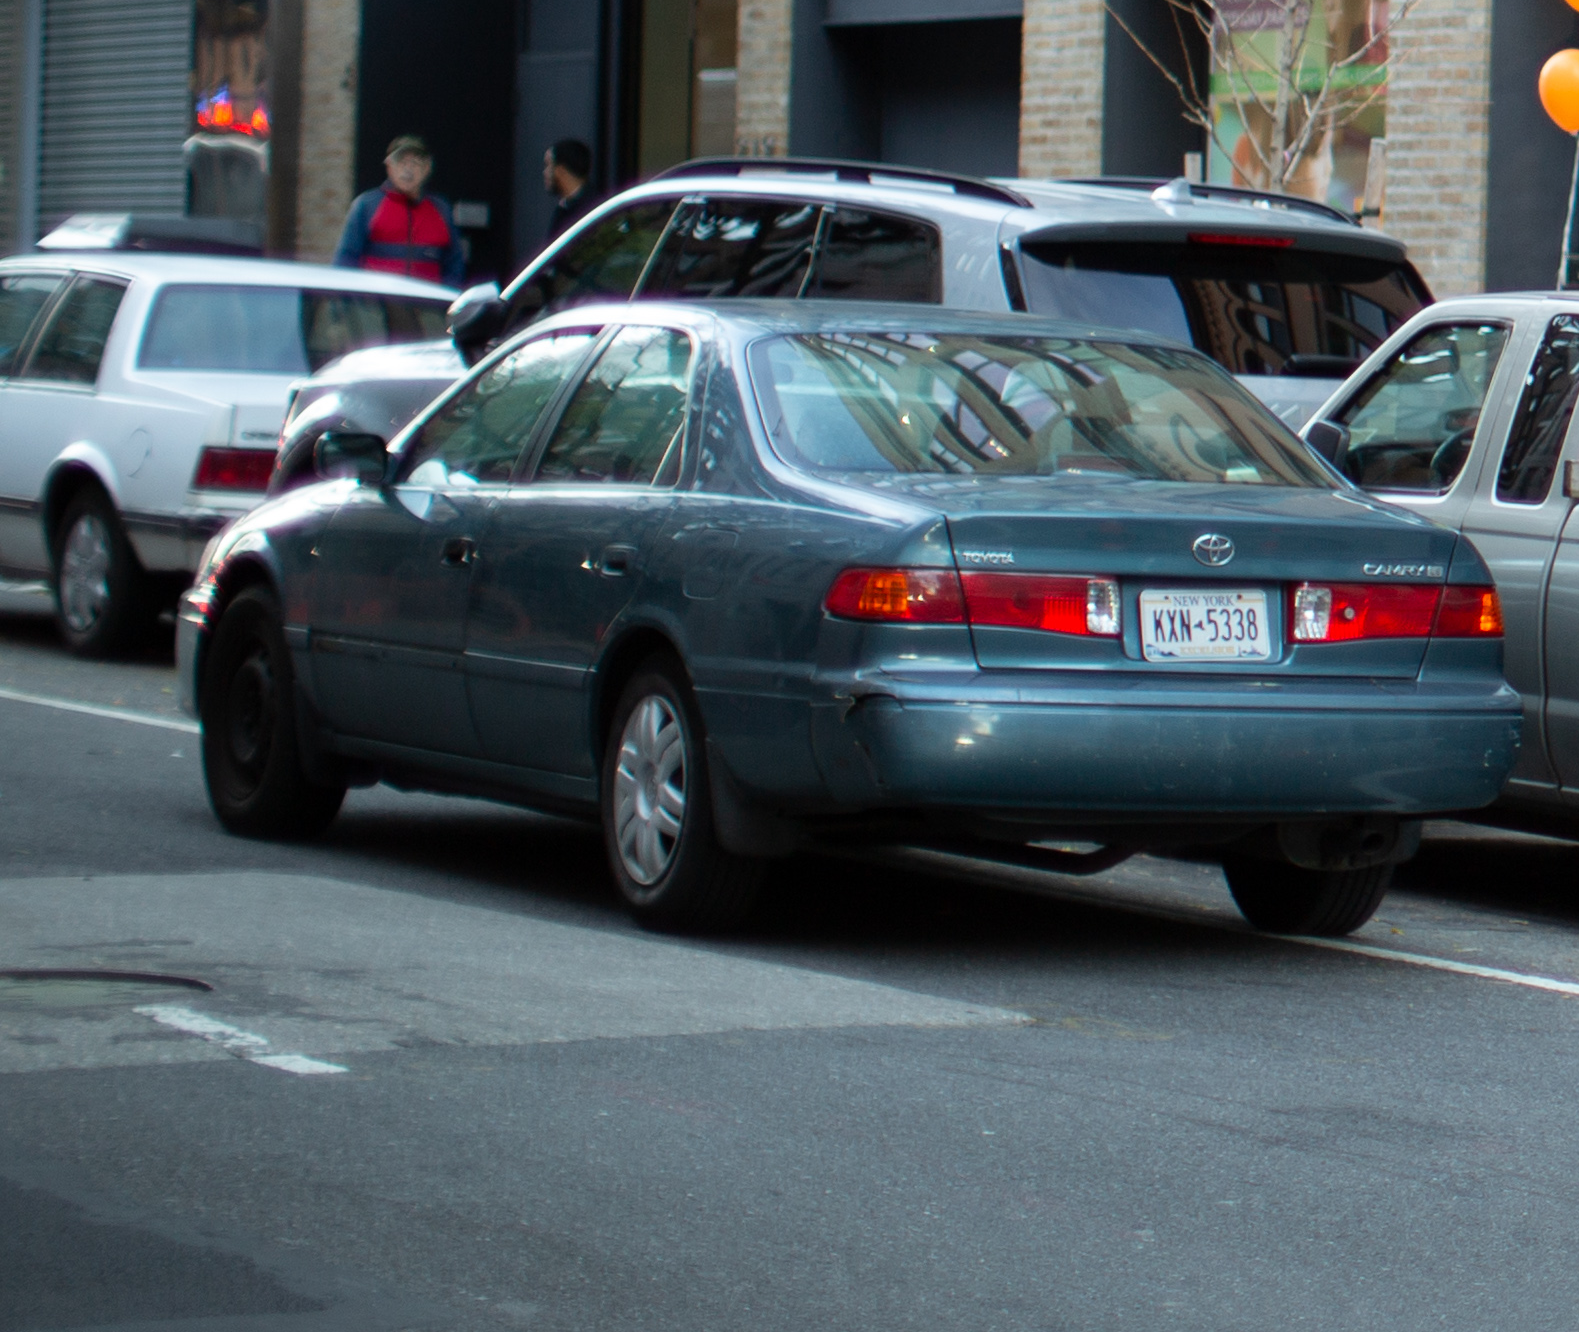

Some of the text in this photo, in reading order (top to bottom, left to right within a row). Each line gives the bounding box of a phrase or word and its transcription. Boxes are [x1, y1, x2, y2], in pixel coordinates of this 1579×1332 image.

[962, 551, 1015, 565] TOYOTA
[1362, 563, 1425, 577] CAMRY
[1173, 594, 1235, 607] NEW YORK
